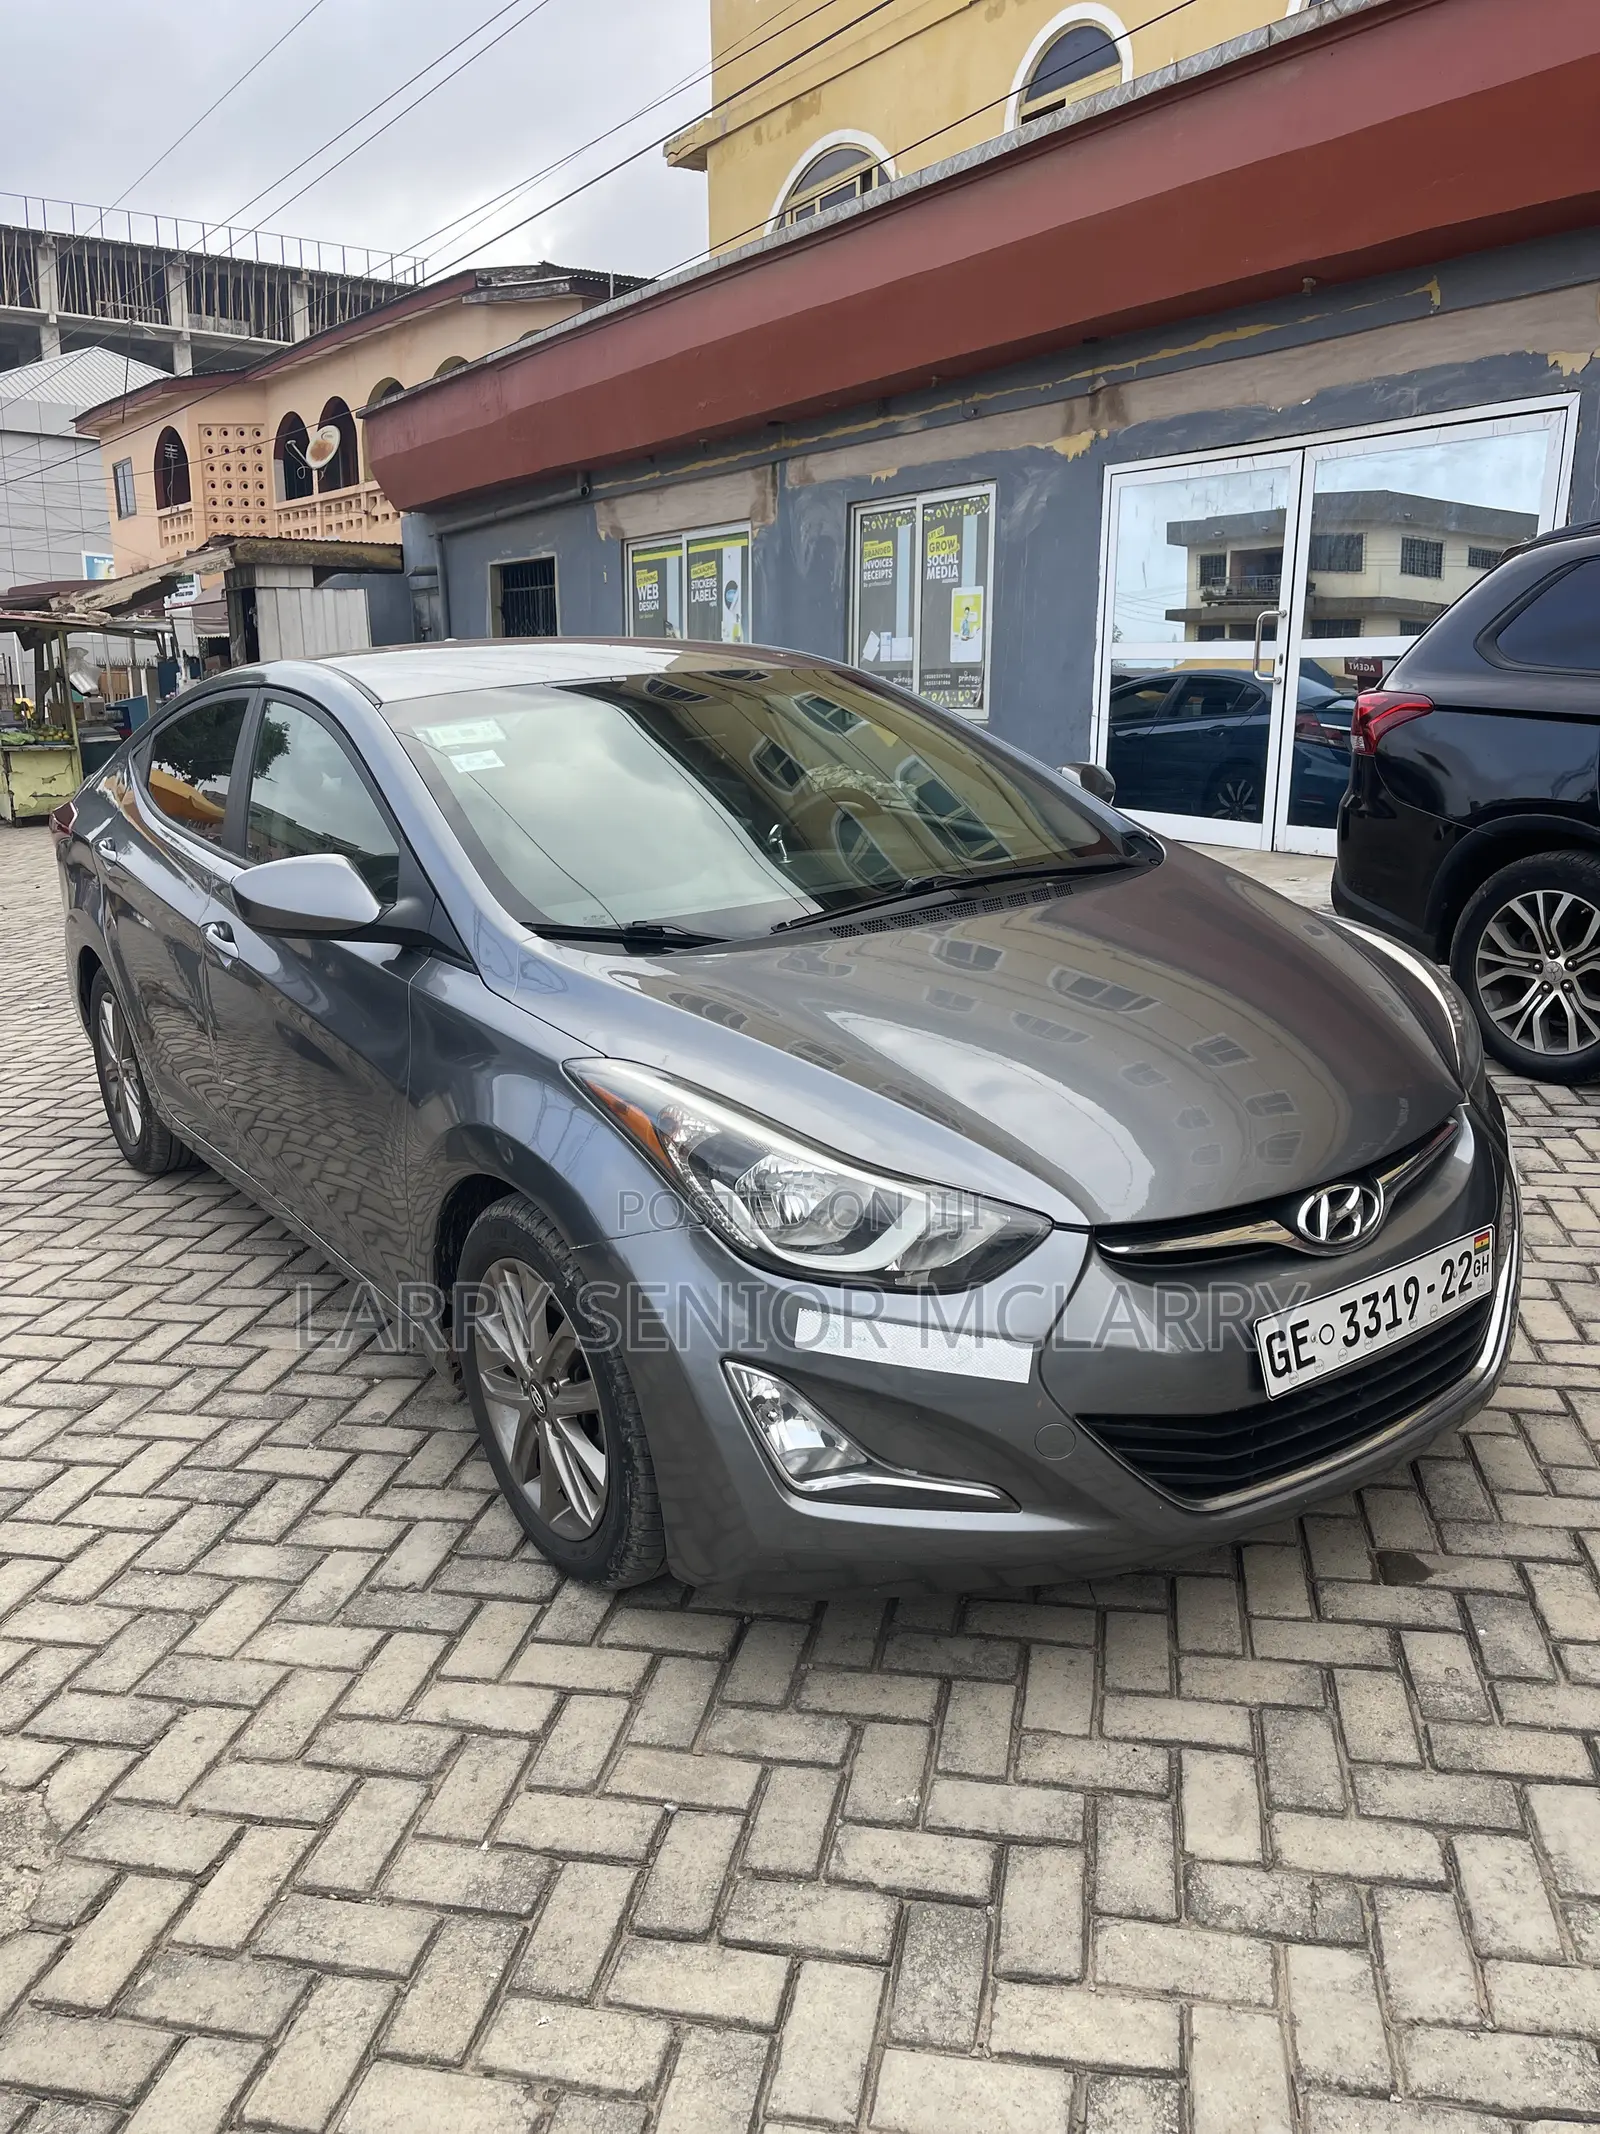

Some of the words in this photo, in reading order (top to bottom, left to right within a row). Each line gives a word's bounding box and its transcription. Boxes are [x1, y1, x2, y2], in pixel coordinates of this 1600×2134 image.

[864, 546, 891, 560] BRANDED
[929, 539, 955, 553] GROW
[864, 558, 893, 570] INVOICES
[927, 553, 958, 567] SOCIAL
[863, 568, 892, 582] RECEIPTS
[927, 565, 958, 580] MEDIA
[691, 577, 717, 589] STICKERS
[637, 583, 659, 601] WEB
[691, 587, 717, 602] LABELS
[639, 600, 659, 611] DESIGN
[1473, 1254, 1489, 1278] GH
[1265, 1318, 1316, 1378] GE
[1339, 1251, 1472, 1347] 3319-22
